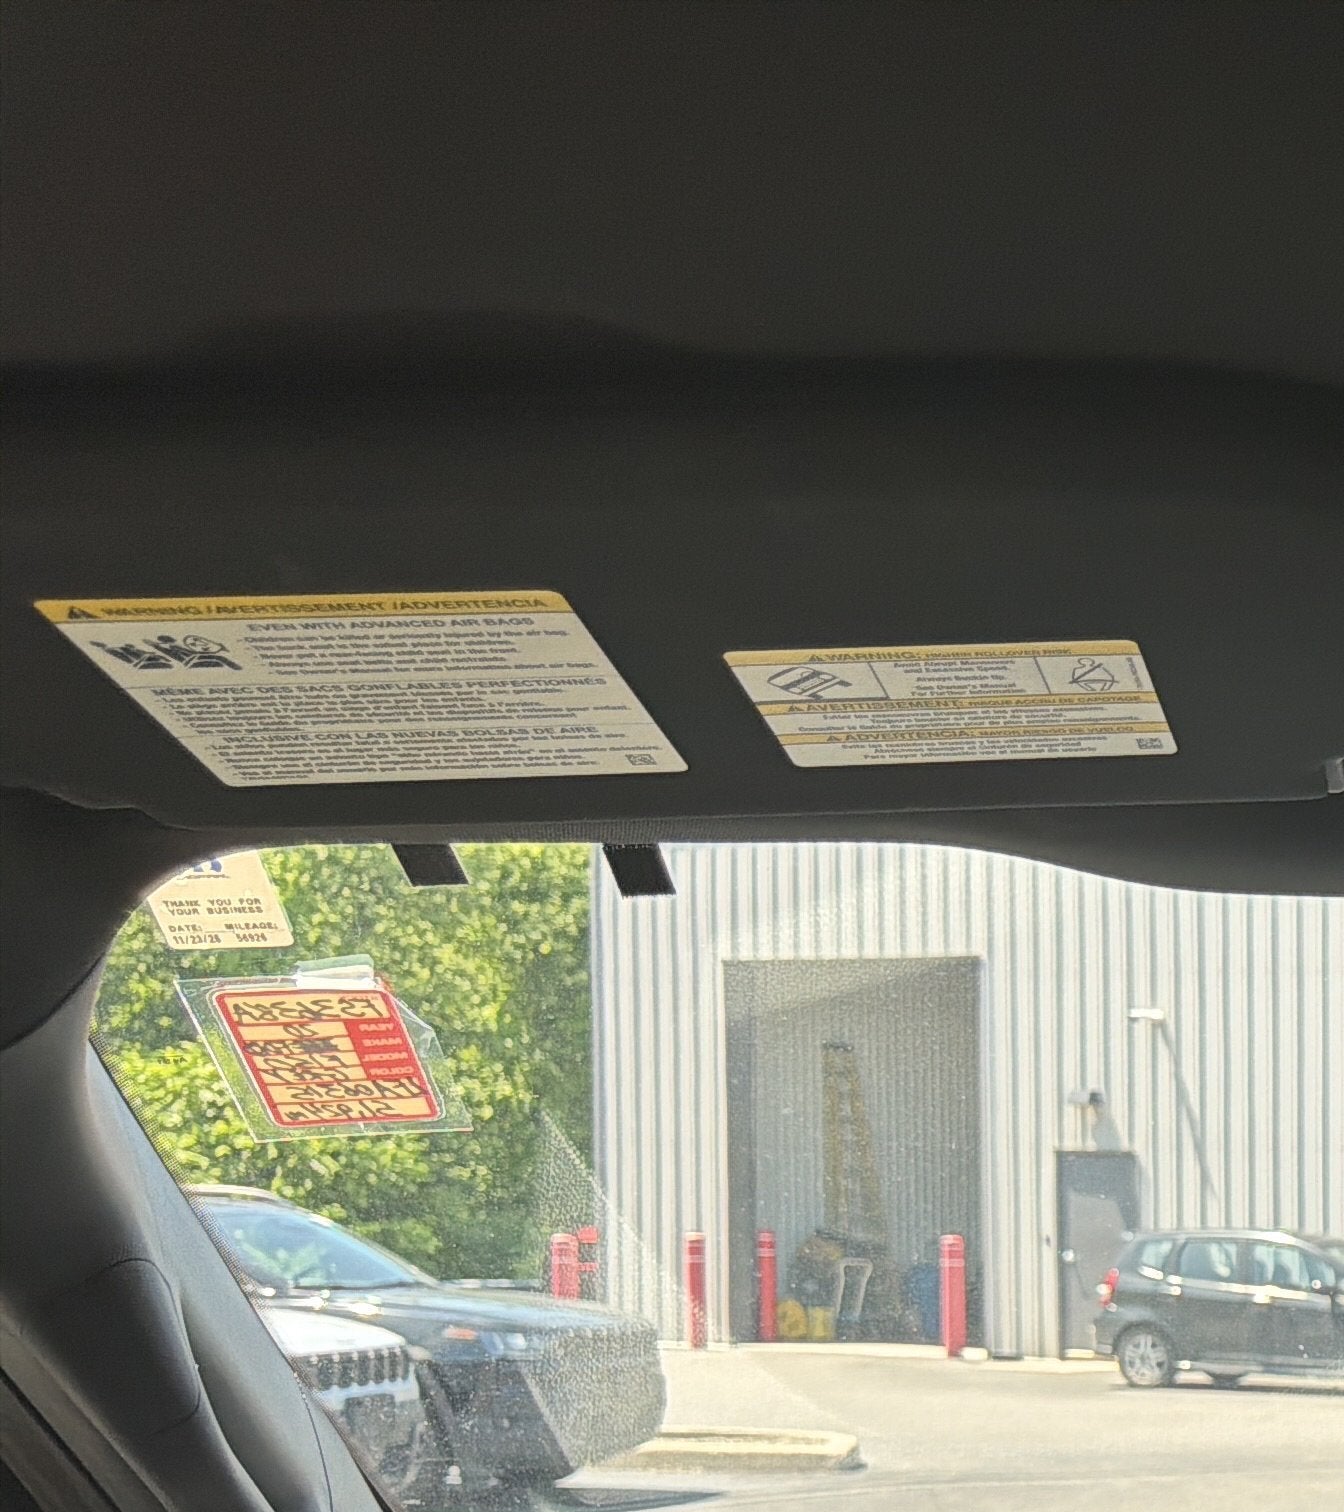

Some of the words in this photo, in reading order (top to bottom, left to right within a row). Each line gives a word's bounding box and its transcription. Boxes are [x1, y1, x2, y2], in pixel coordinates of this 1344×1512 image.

[351, 620, 445, 629] ADVANCED
[451, 618, 479, 627] AIR
[482, 617, 534, 626] BAGS
[208, 899, 231, 907] YOU
[238, 898, 262, 906] FOR
[206, 906, 263, 914] BUSINESS
[168, 924, 203, 933] DATE:
[224, 922, 279, 931] MILEAGE:
